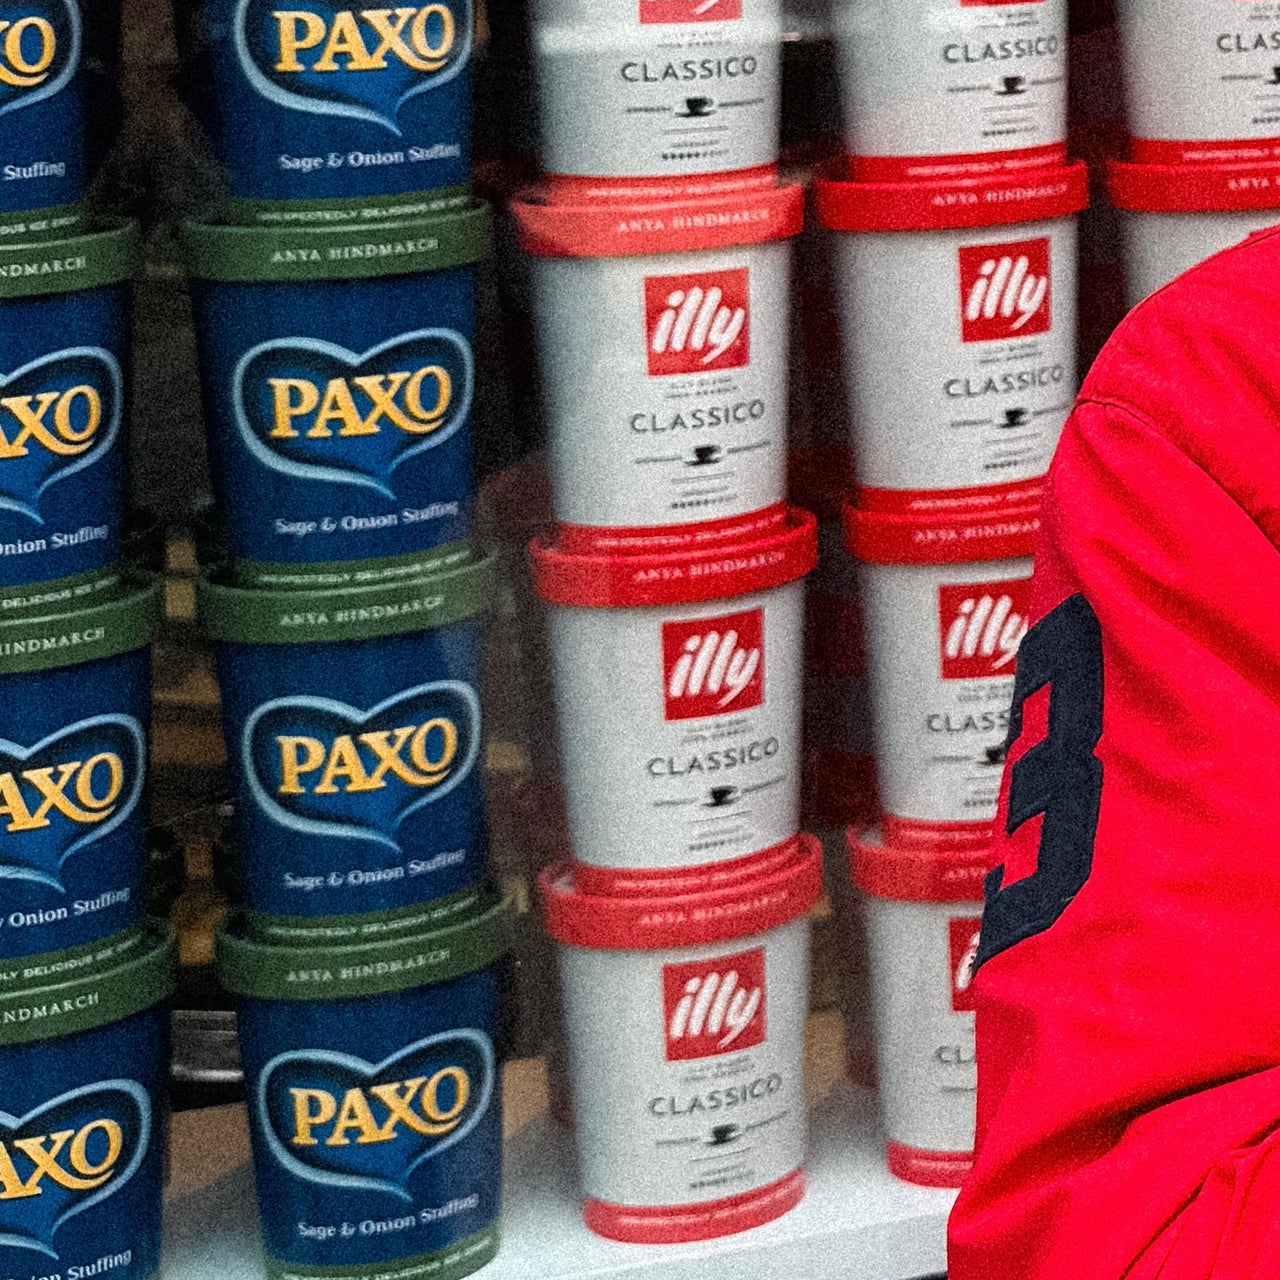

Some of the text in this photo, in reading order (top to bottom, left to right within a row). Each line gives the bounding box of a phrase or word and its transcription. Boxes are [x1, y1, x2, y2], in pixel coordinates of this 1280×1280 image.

[272, 2, 456, 73] PAXO
[942, 35, 1059, 65] CLASSICO
[621, 56, 758, 83] CLASSICO
[280, 153, 324, 173] Sage
[327, 151, 342, 168] &
[348, 147, 405, 168] Onion
[966, 256, 1050, 332] illy
[653, 286, 747, 366] illy
[267, 365, 452, 440] PAXO
[943, 365, 1065, 399] CLASSICO
[630, 400, 766, 434] CLASSICO
[275, 511, 398, 536] Sage Onion
[668, 628, 762, 707] illy
[278, 718, 459, 795] PAXO
[648, 737, 780, 778] CLASSICO
[0, 752, 124, 832] AXO
[349, 865, 404, 886] Onion
[9, 886, 131, 928] Onion Stuffing
[669, 969, 761, 1048] illy
[289, 1065, 470, 1148] PAXO
[647, 1073, 784, 1117] CLASSICO
[0, 1118, 122, 1200] AXO
[299, 1221, 338, 1239] Sage
[360, 1216, 416, 1237] Onion
